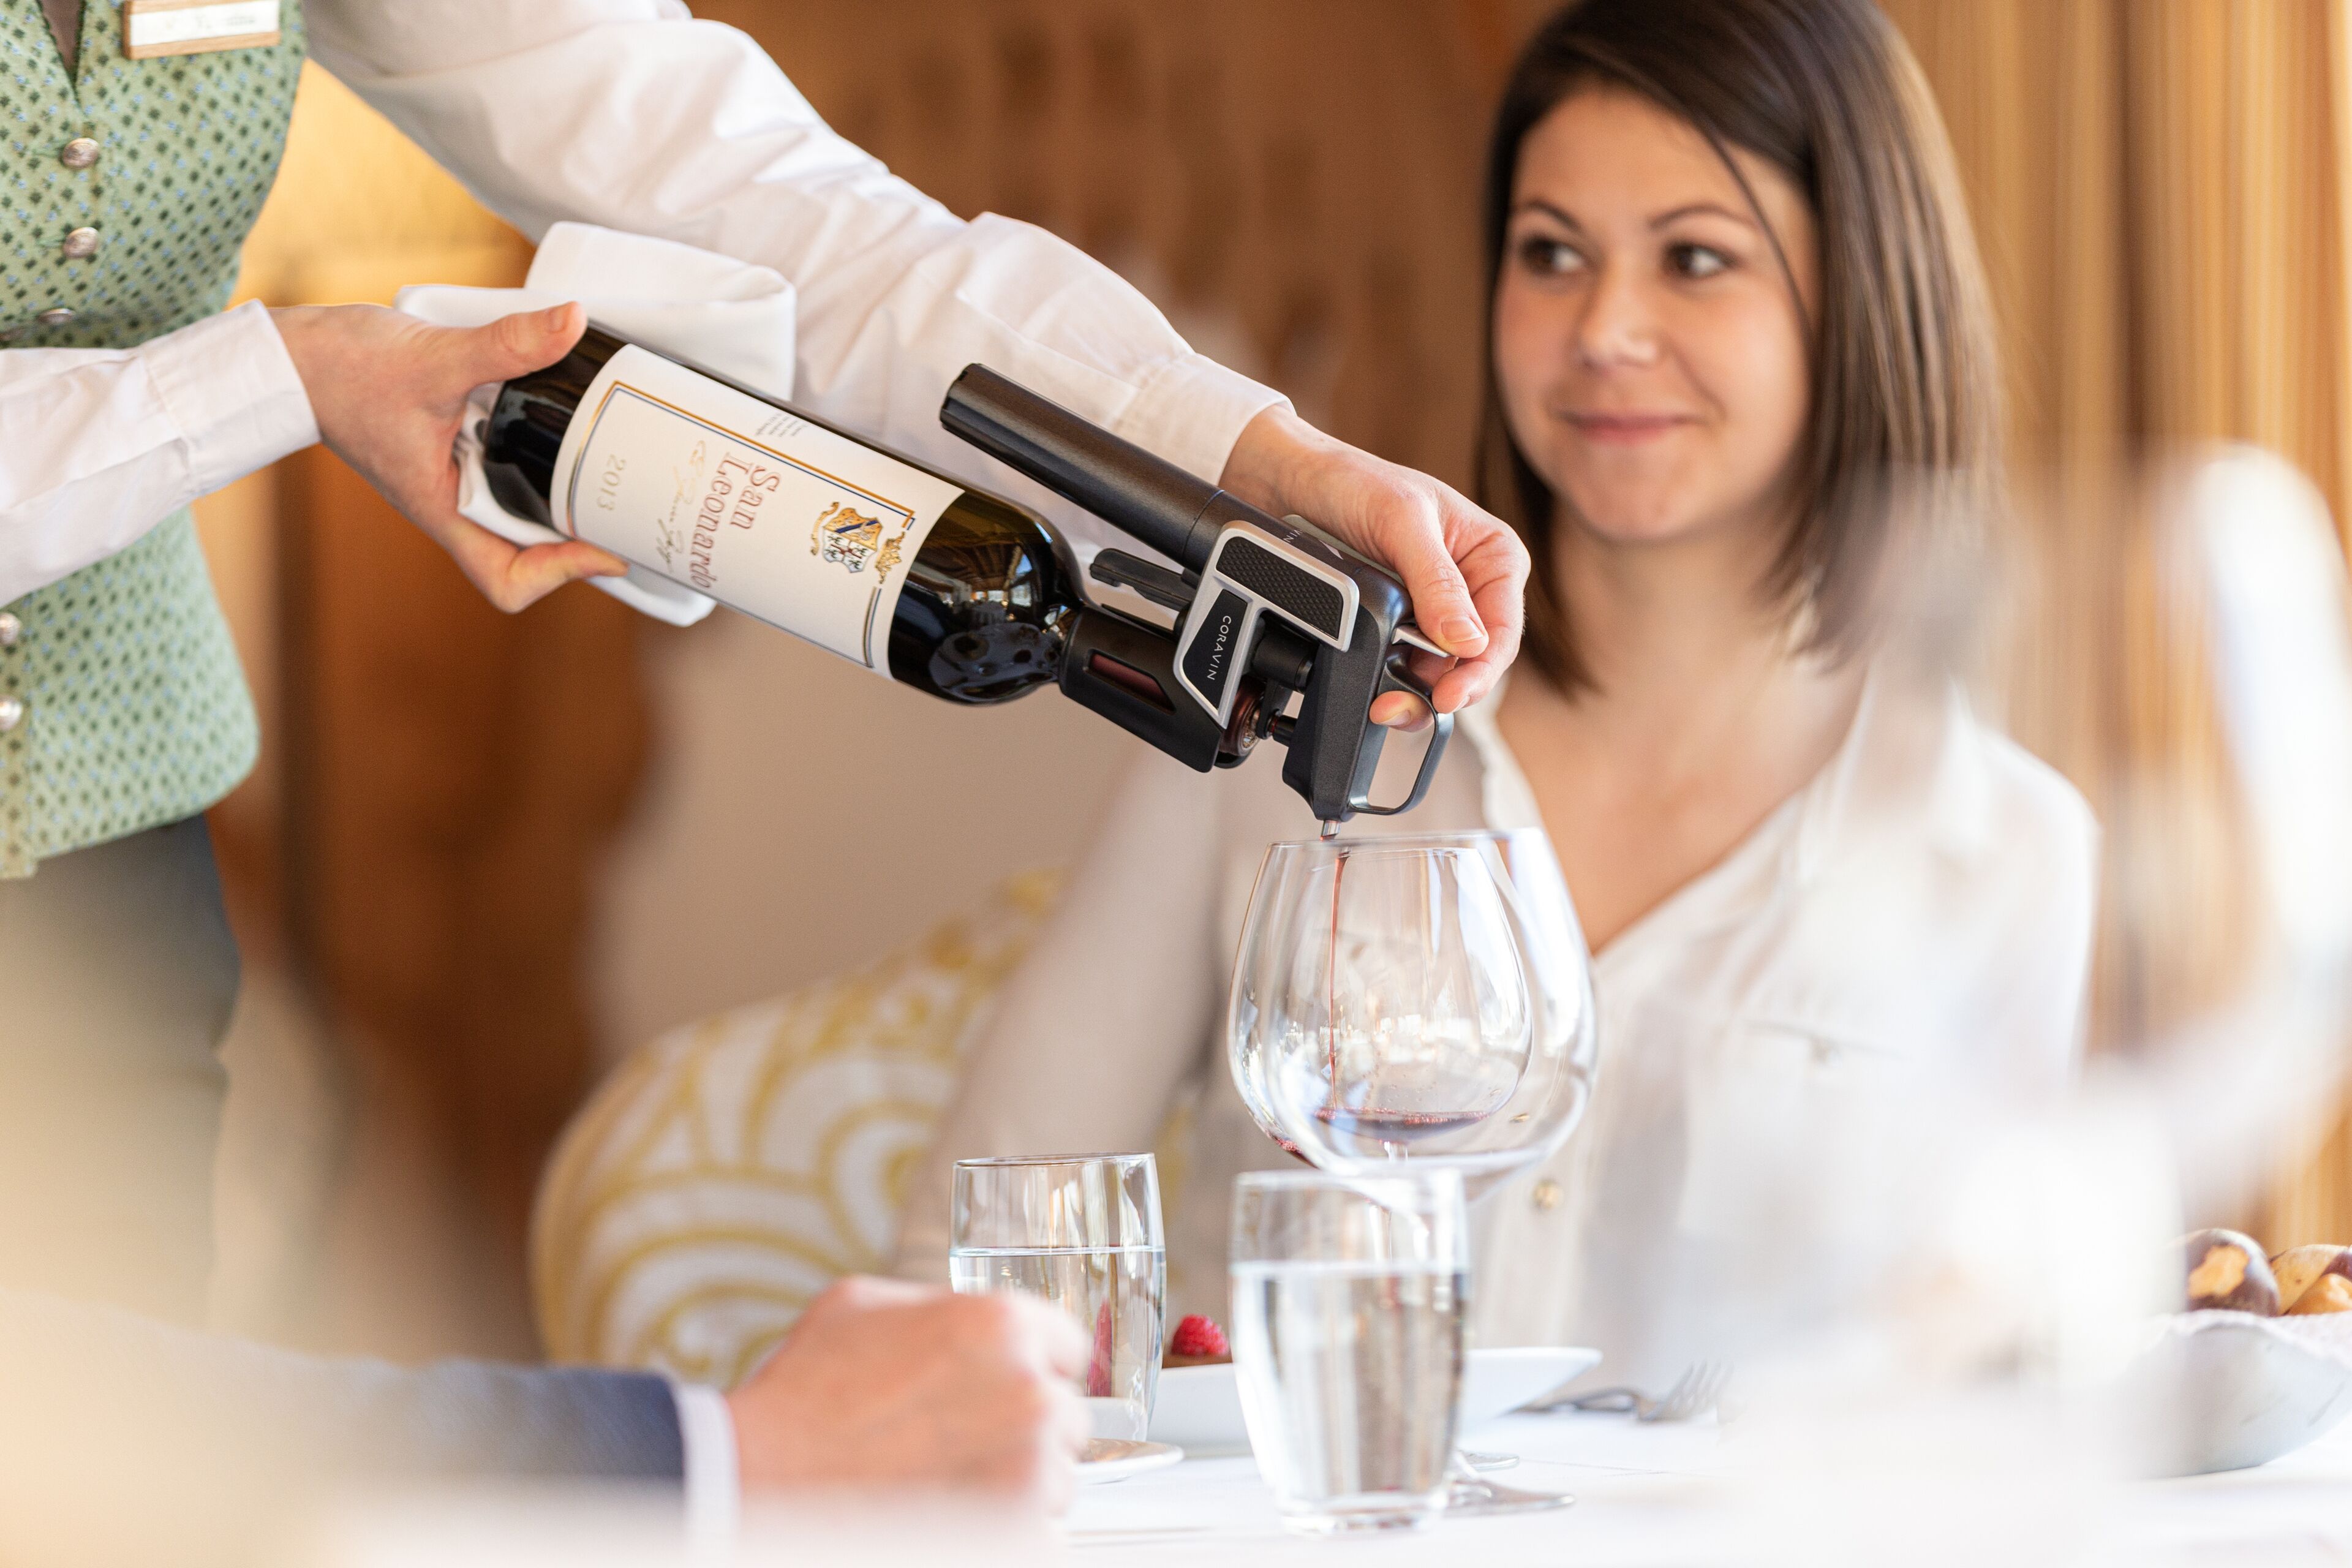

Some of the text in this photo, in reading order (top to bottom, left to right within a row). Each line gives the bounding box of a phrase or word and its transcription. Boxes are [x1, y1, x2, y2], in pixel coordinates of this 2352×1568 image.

[597, 453, 628, 511] 2013
[729, 464, 782, 530] San
[689, 451, 753, 588] Leonardo
[1207, 615, 1232, 680] CORAVIN
